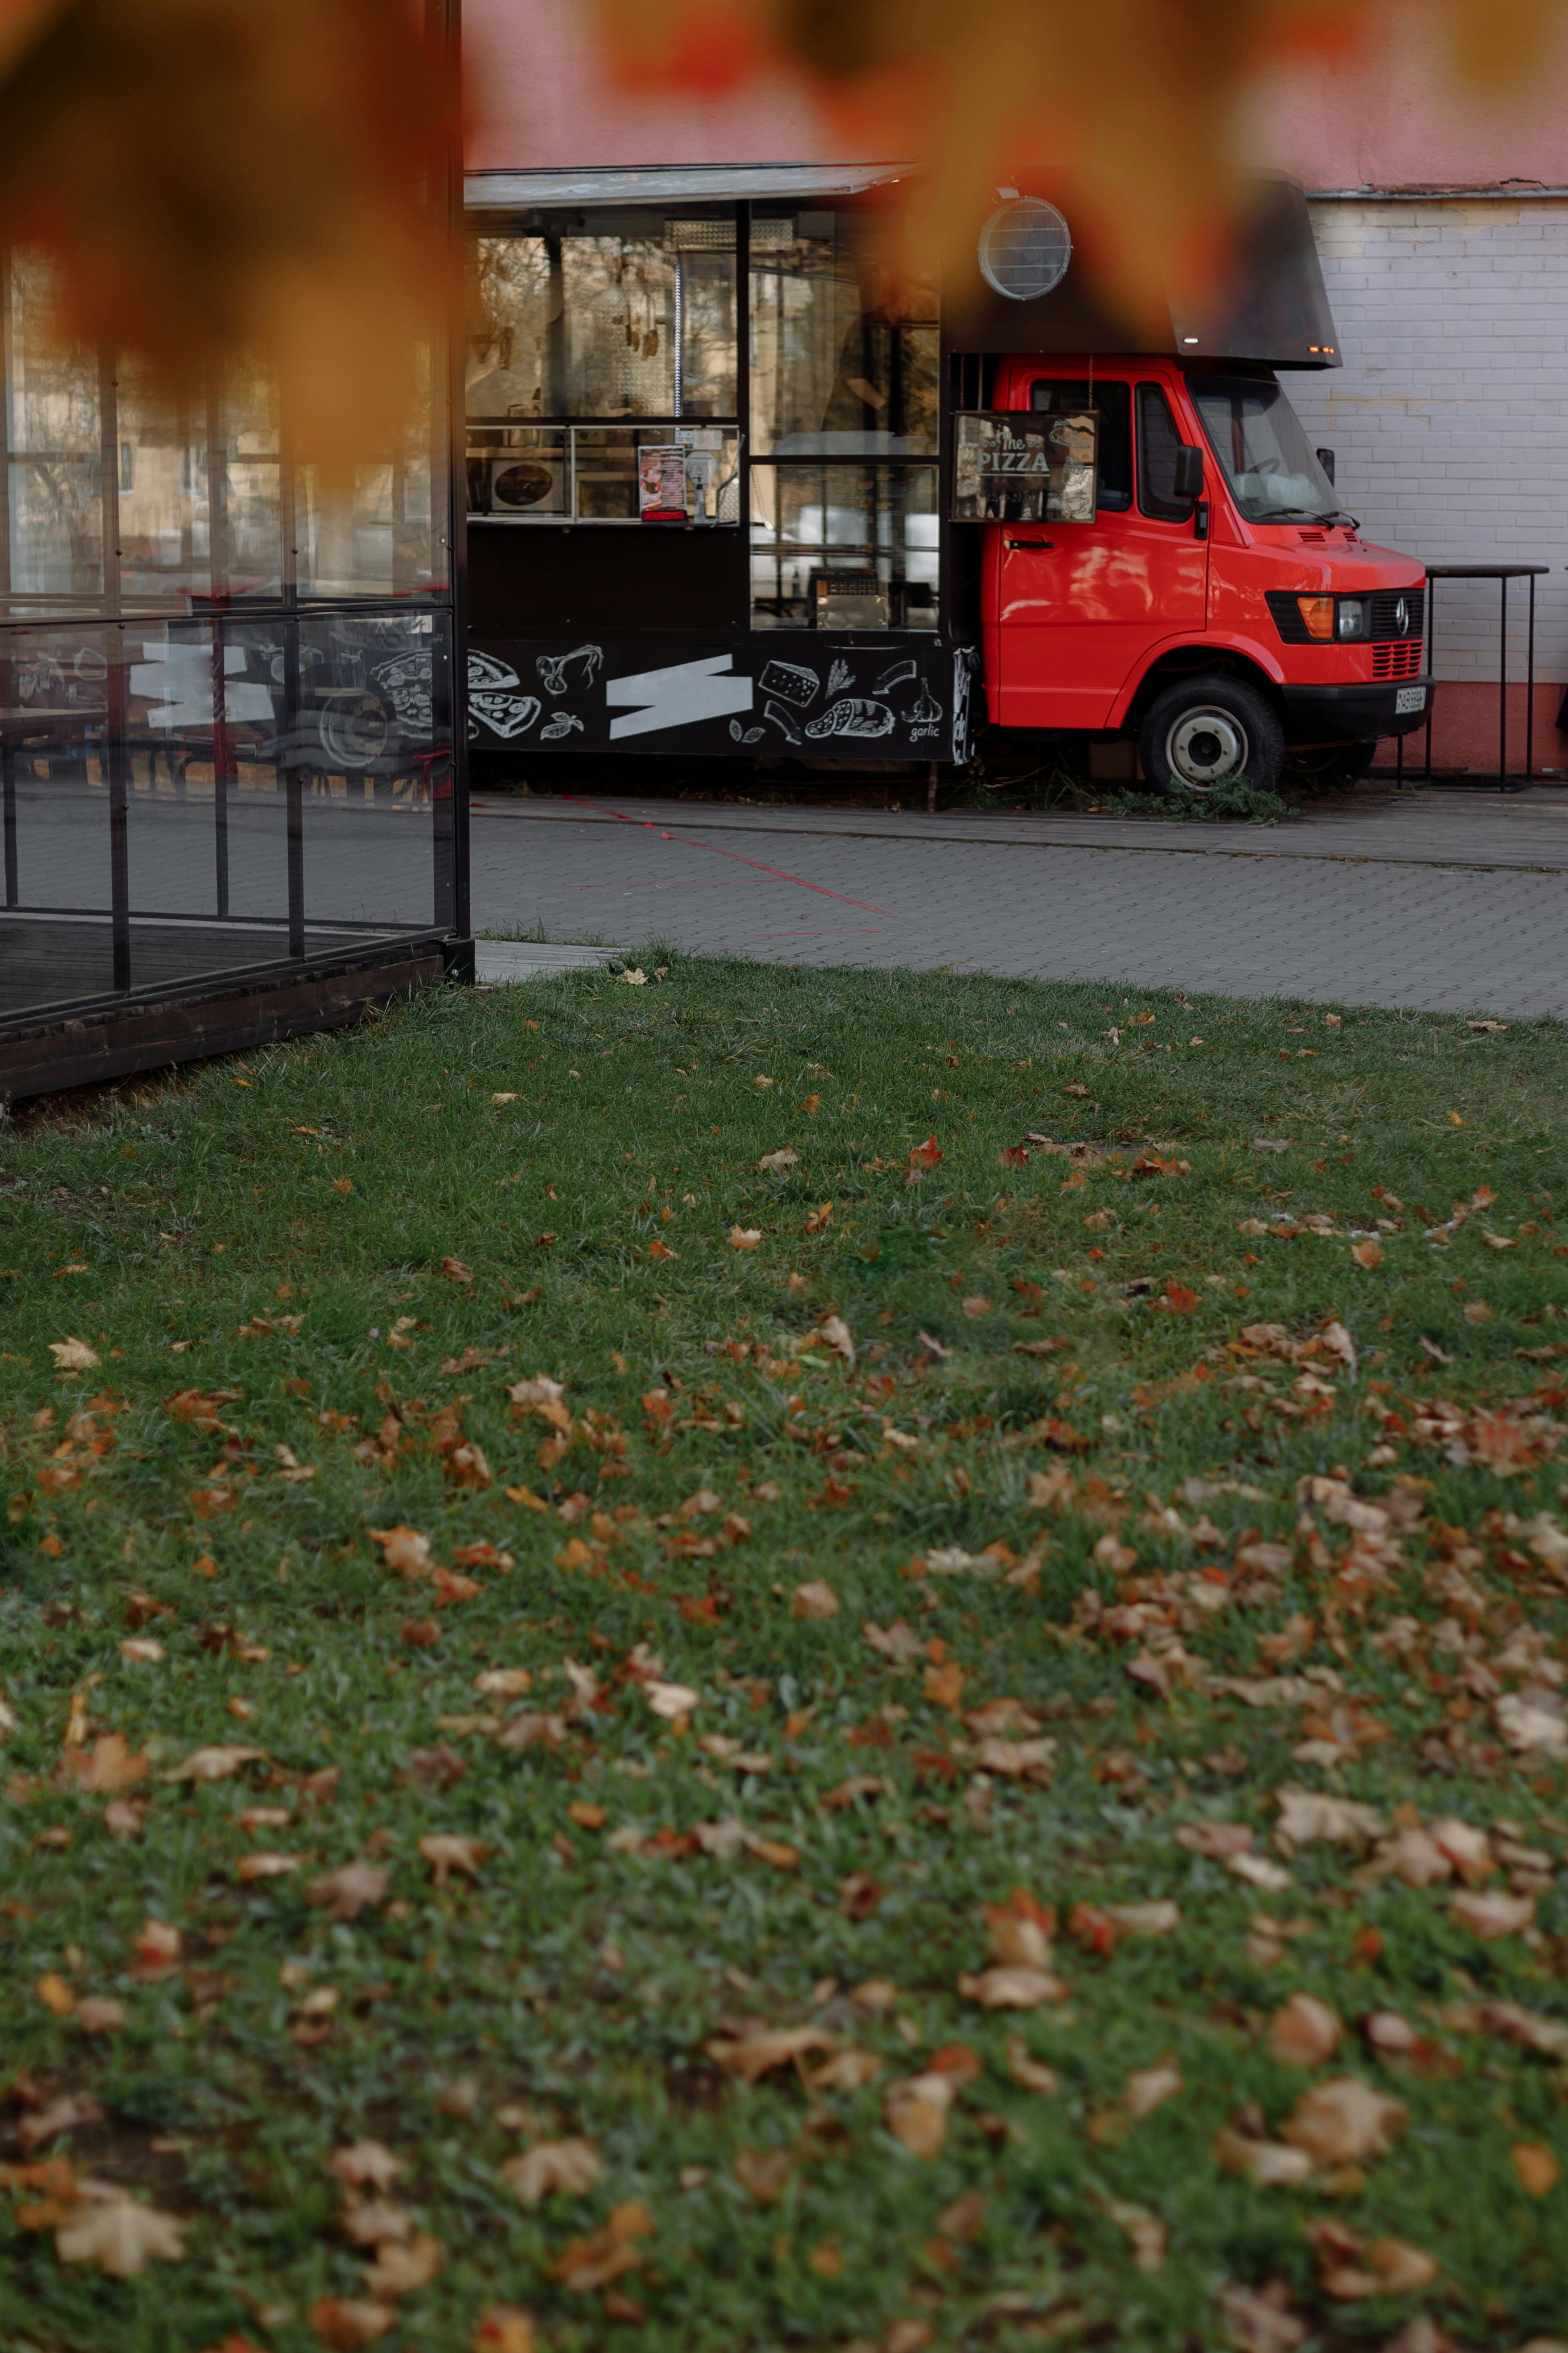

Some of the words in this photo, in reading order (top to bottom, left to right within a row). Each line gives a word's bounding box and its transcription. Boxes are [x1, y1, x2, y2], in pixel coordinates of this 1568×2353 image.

[996, 431, 1026, 451] The
[977, 452, 1050, 472] PIZZA
[910, 723, 940, 743] garlic
